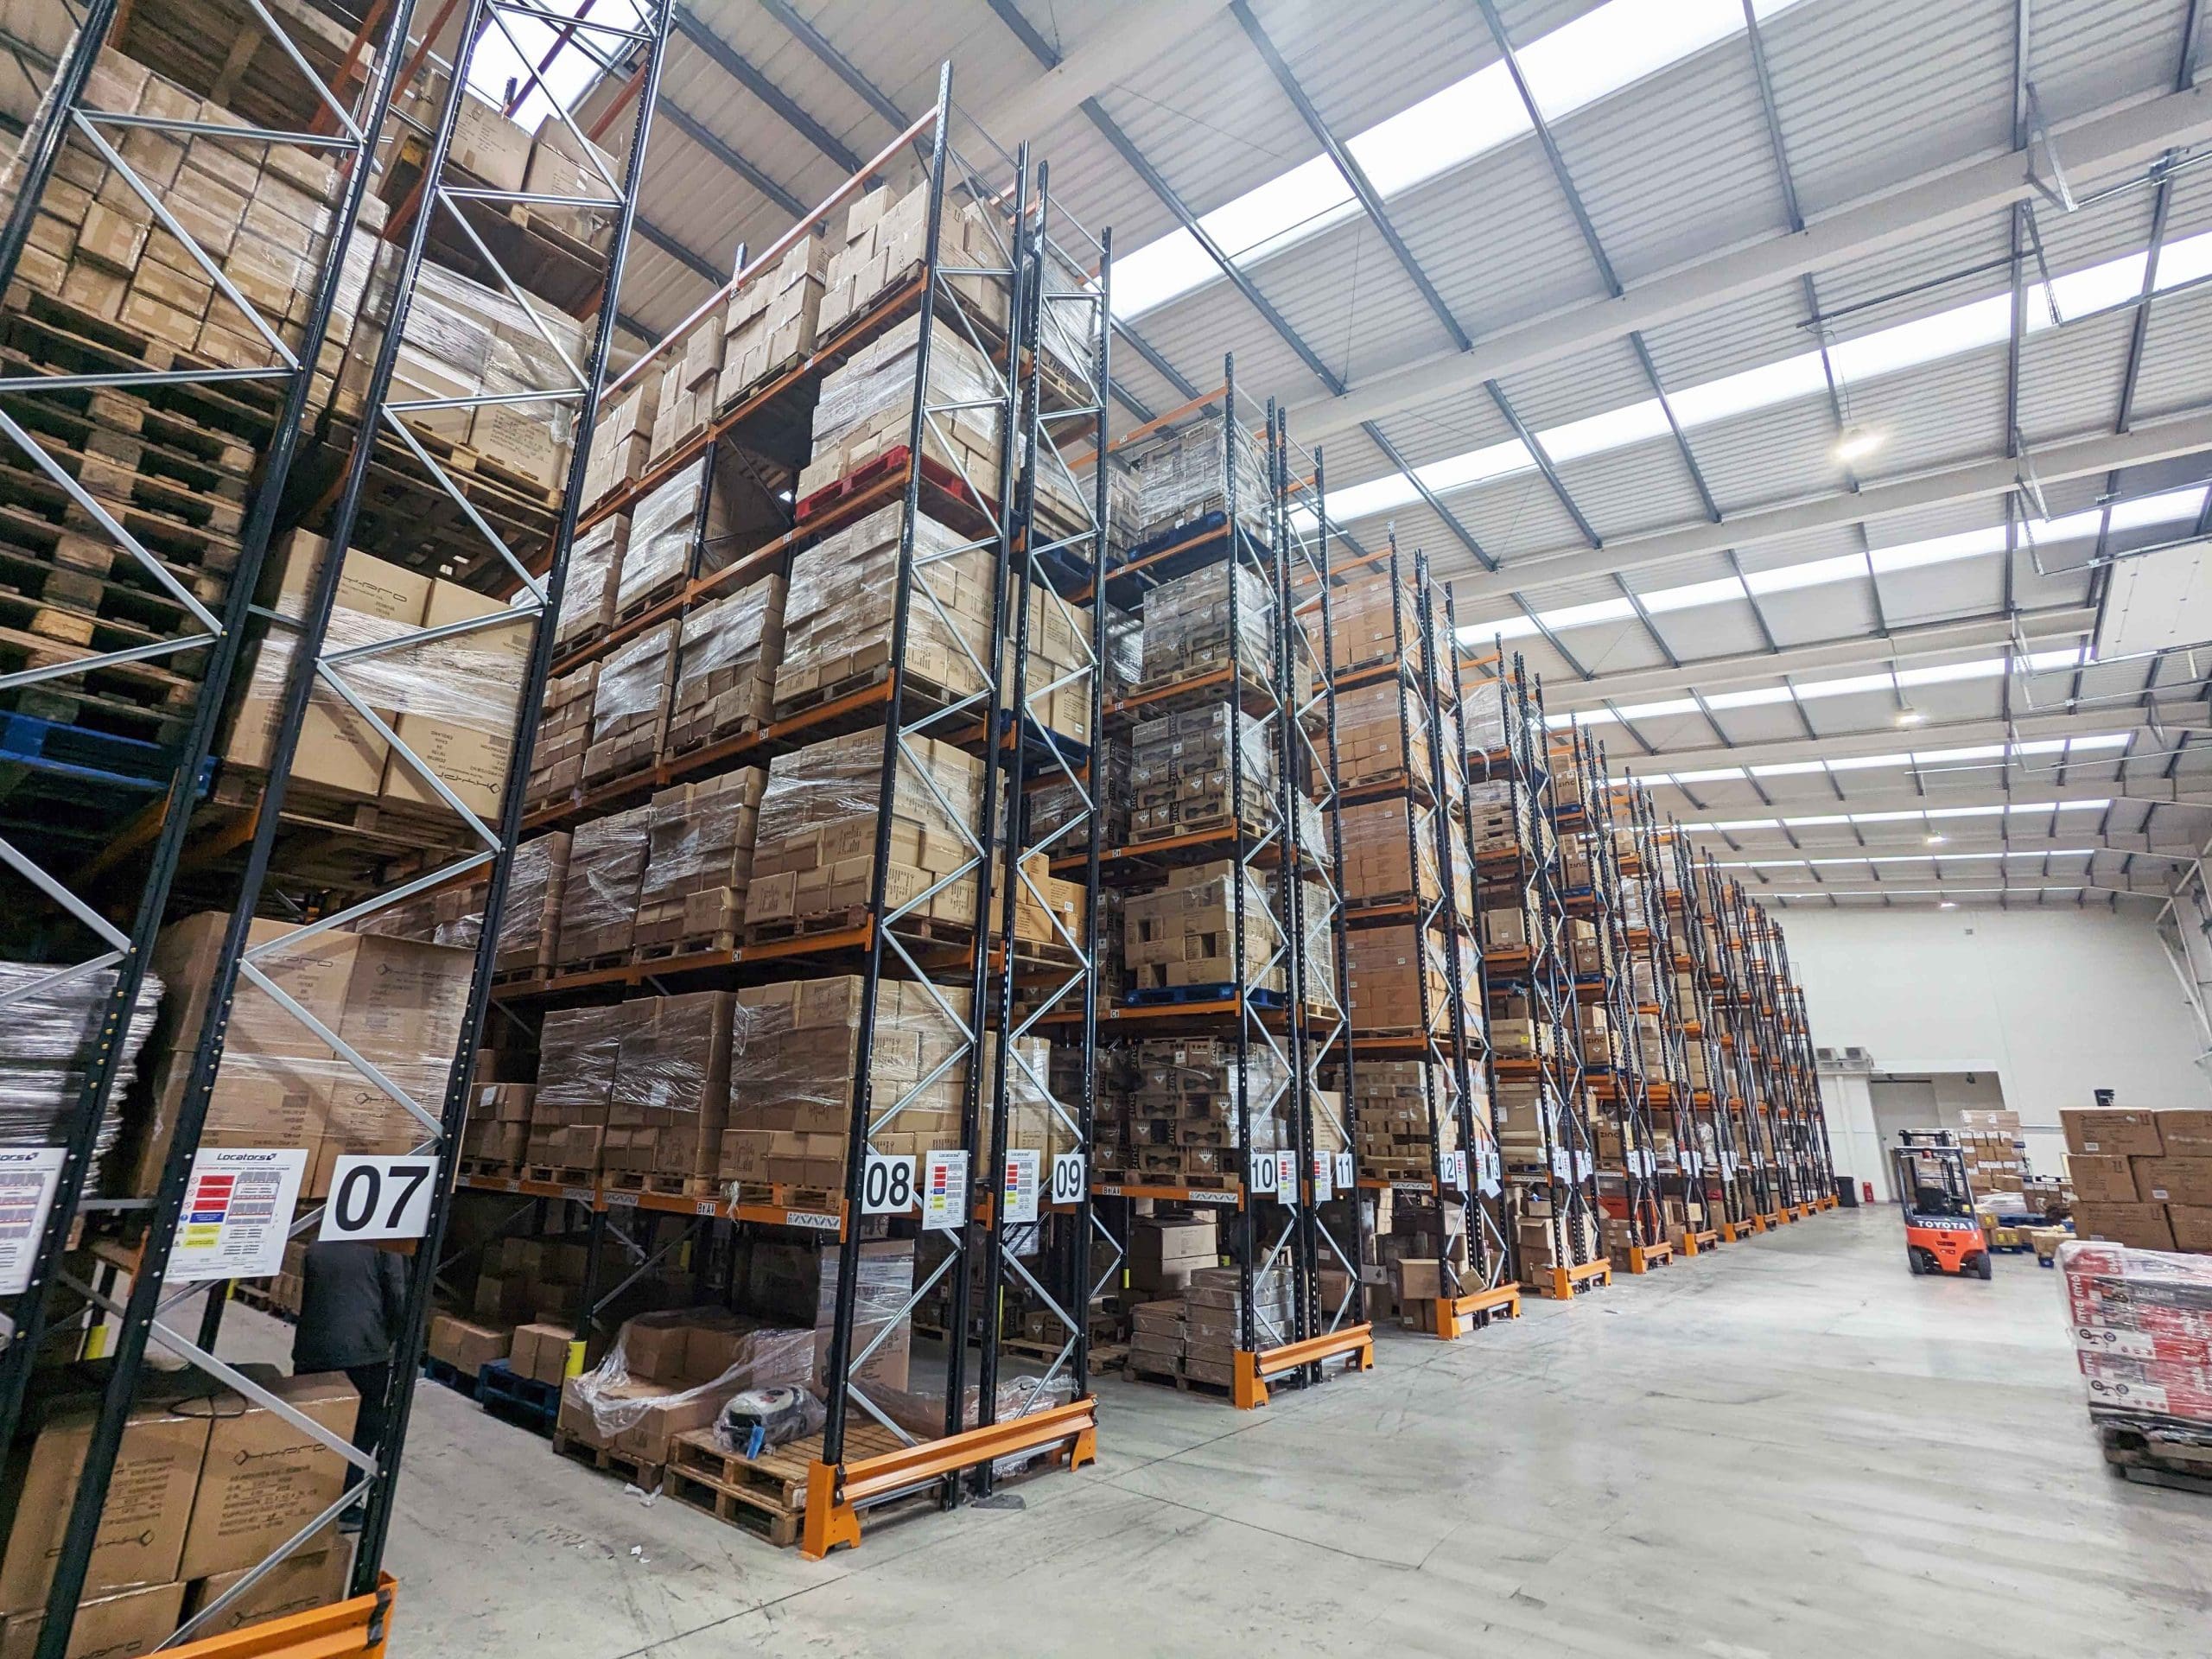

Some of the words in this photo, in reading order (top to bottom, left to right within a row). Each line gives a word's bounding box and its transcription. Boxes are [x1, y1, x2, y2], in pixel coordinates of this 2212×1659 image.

[1056, 1160, 1081, 1198] 09
[1251, 1158, 1274, 1189] 10
[1338, 1158, 1351, 1184] 11
[1441, 1156, 1454, 1179] 12
[1491, 1156, 1499, 1176] 13
[334, 1165, 431, 1231] 07
[866, 1161, 910, 1207] 08
[1917, 1220, 1967, 1230] TOYOTA
